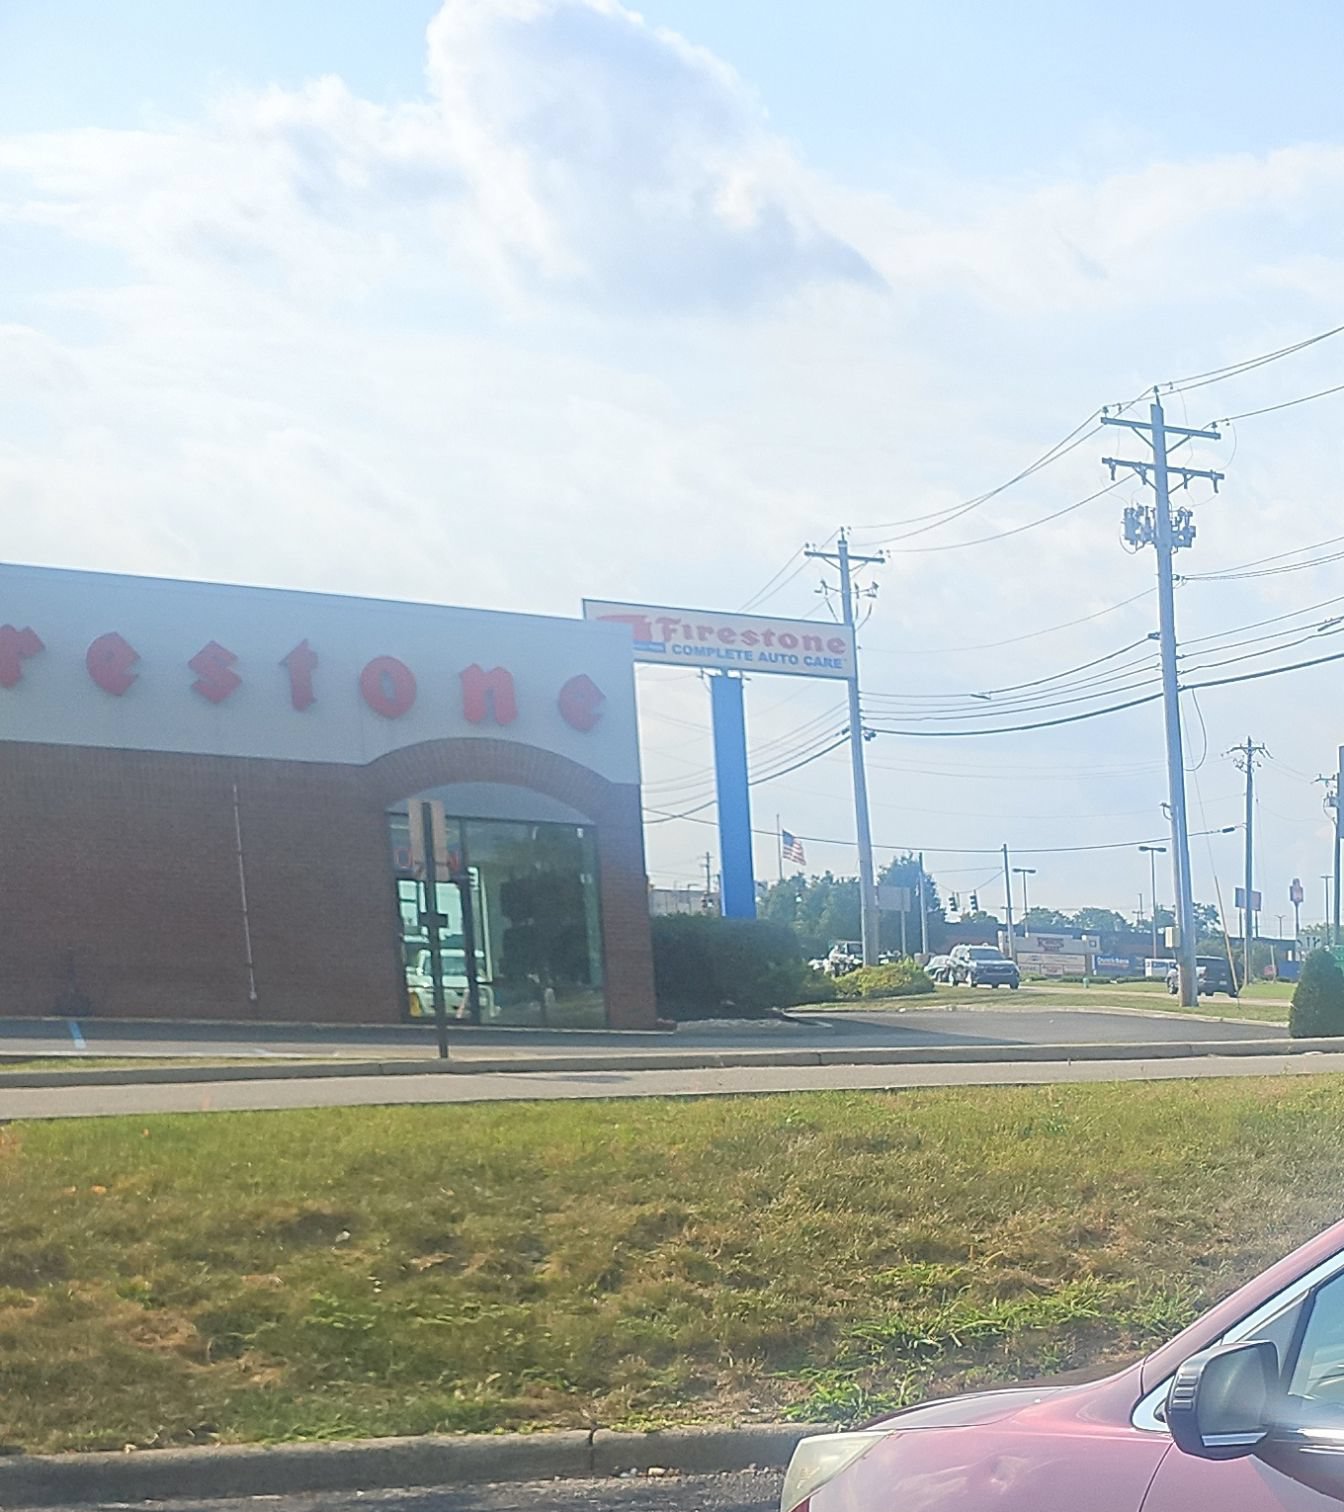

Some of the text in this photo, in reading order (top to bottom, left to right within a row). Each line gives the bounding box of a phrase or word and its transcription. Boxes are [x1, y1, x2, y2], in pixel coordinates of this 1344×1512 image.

[655, 617, 846, 656] Firestone
[672, 643, 843, 669] COMPLETE AUTO CARE
